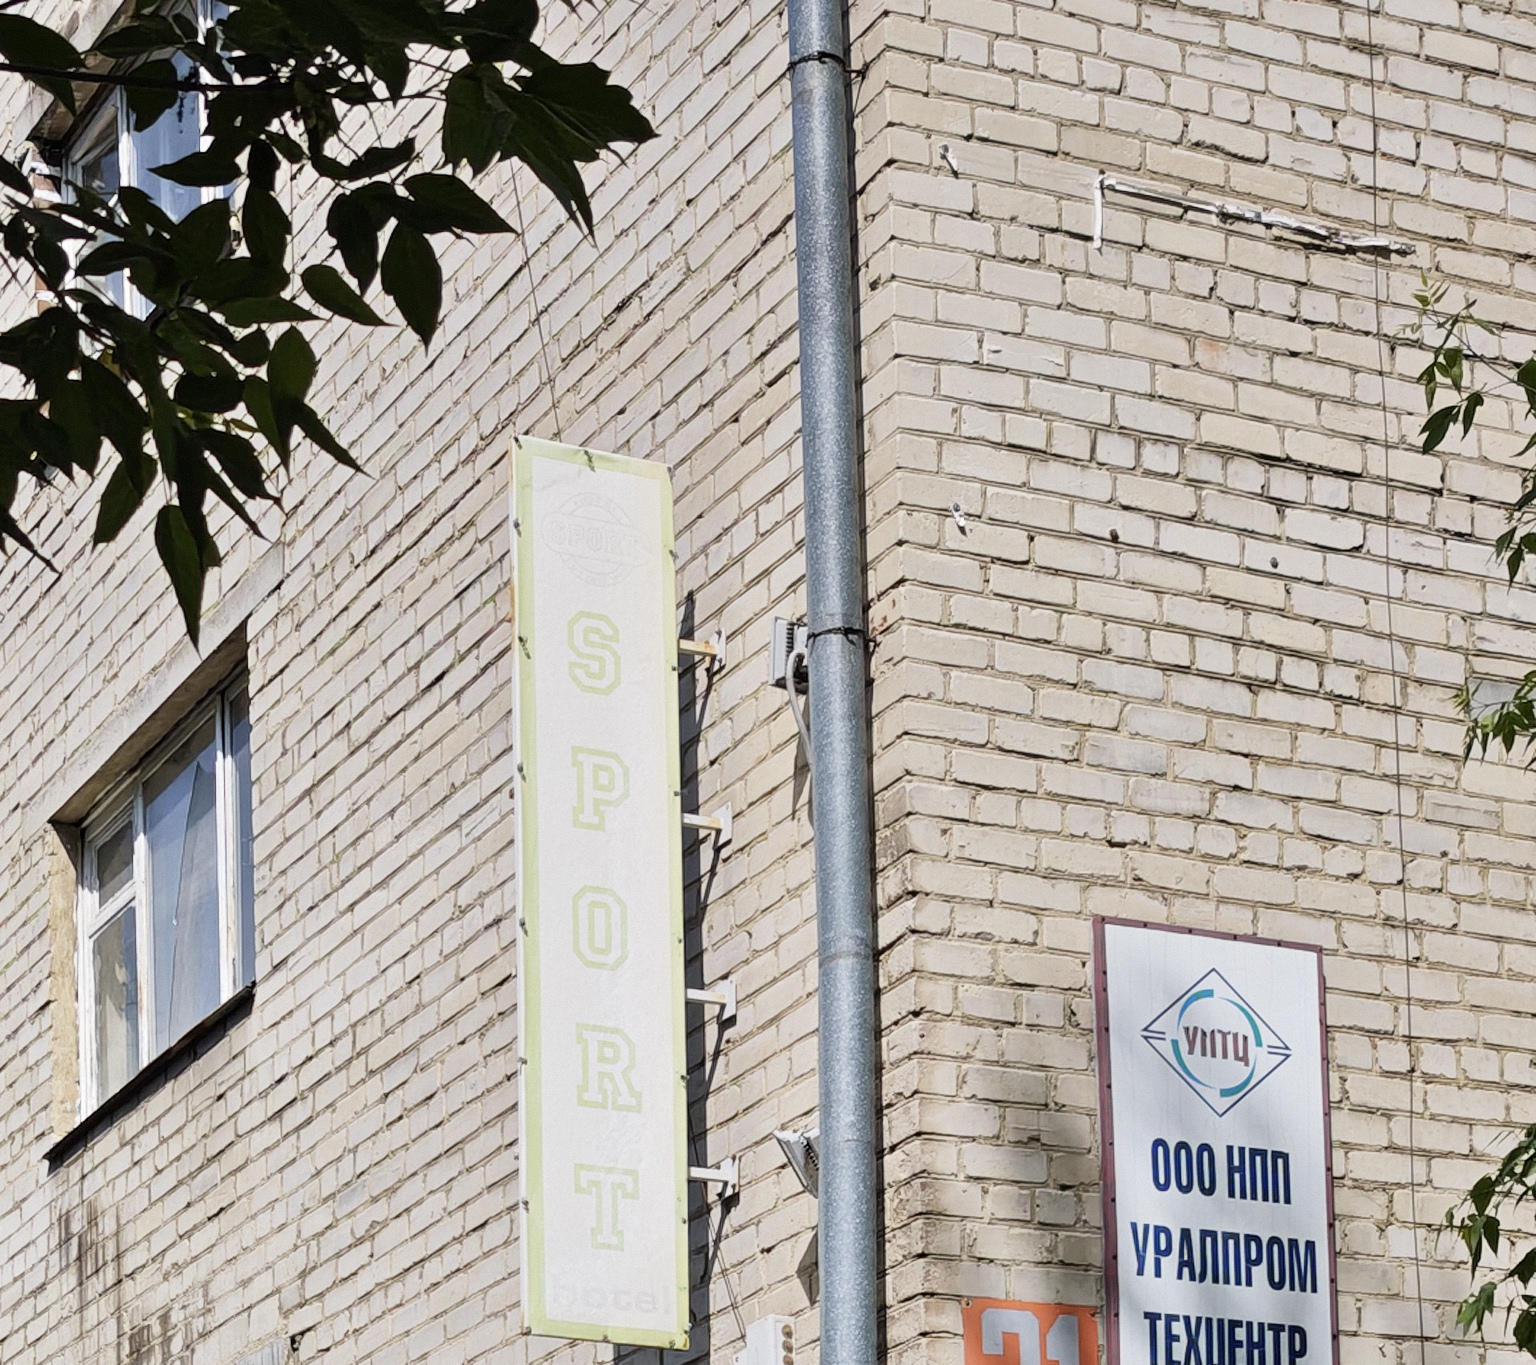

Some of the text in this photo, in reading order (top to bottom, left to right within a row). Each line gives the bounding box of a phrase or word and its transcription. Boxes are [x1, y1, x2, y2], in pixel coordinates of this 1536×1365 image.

[567, 609, 642, 1253] SPORT
[1150, 1137, 1292, 1205] ООО НПП
[1131, 1221, 1318, 1295] УРАЛПРОМ
